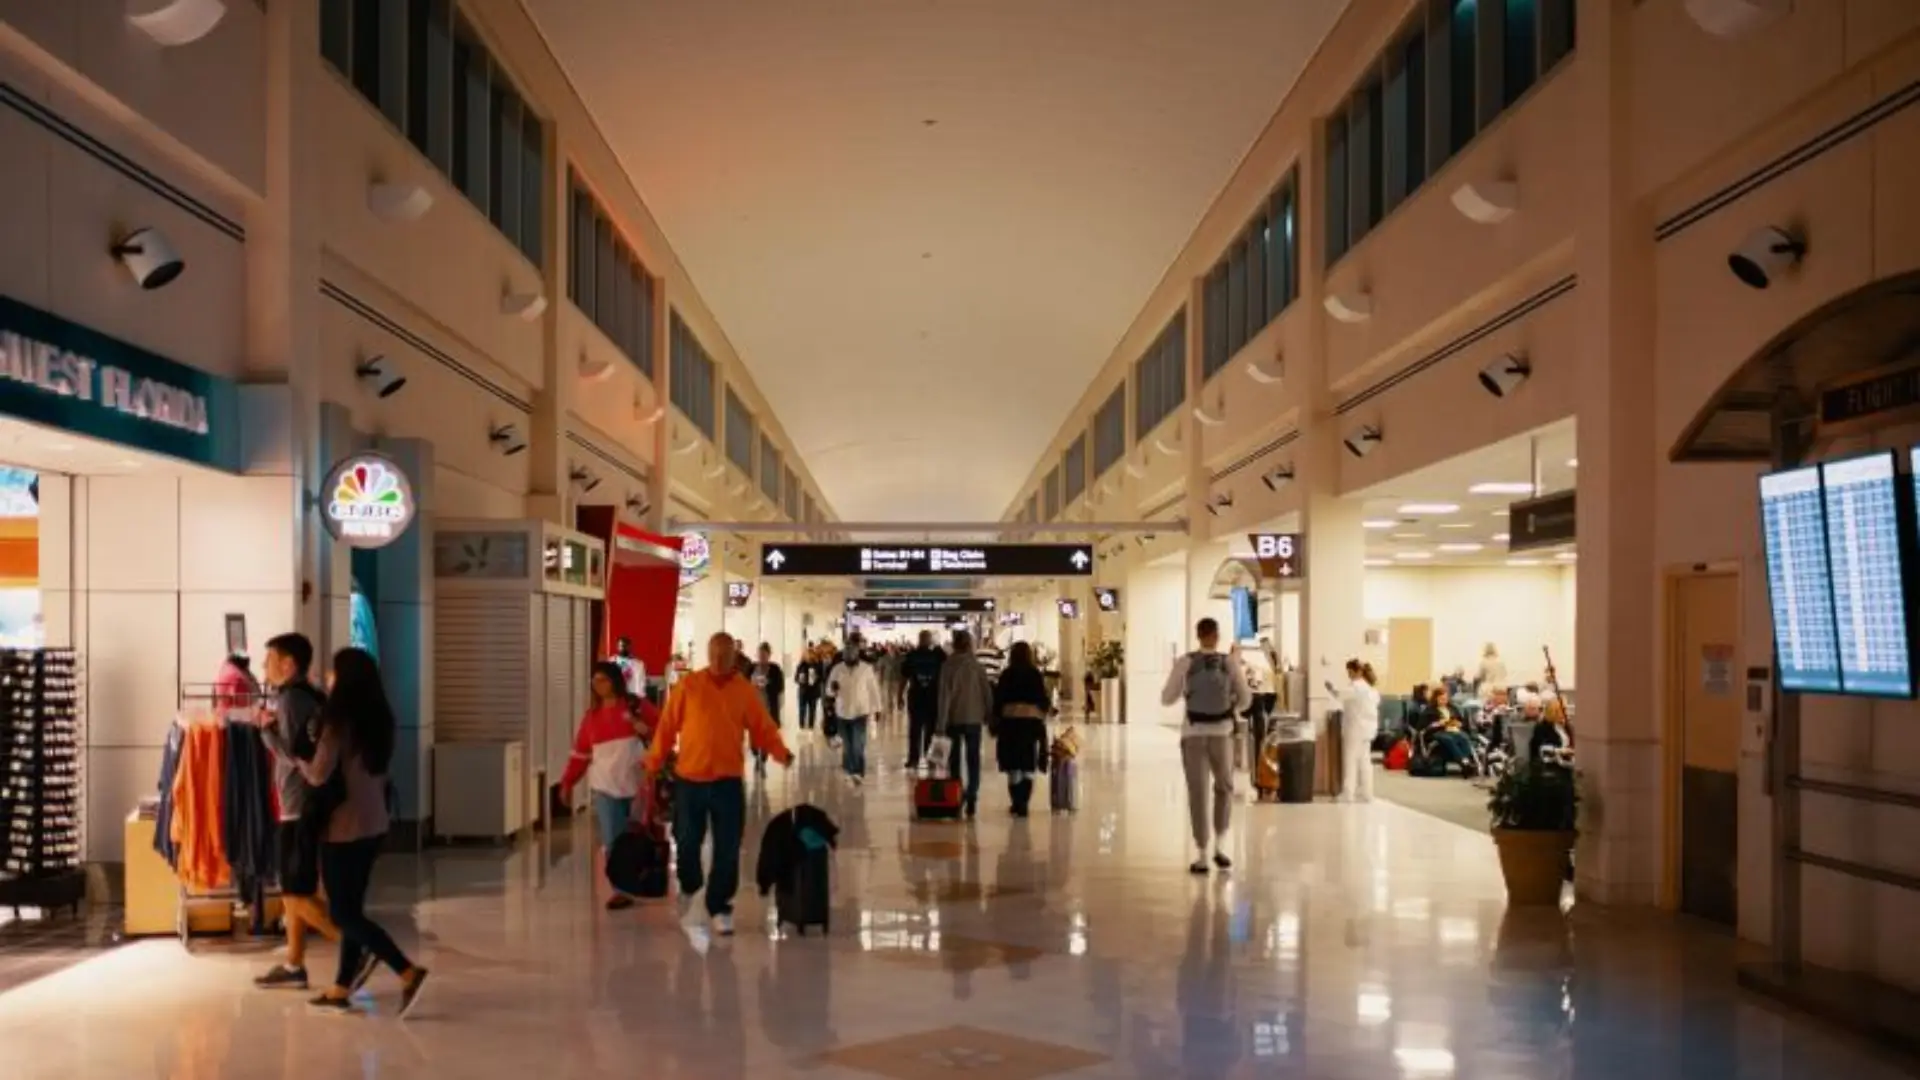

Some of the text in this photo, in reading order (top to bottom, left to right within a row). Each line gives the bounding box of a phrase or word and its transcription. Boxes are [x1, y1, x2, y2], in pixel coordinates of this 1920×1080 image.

[101, 365, 209, 435] FLORIDA
[1846, 378, 1903, 413] FLIGH
[328, 501, 406, 522] CNBC
[1258, 535, 1293, 558] B6
